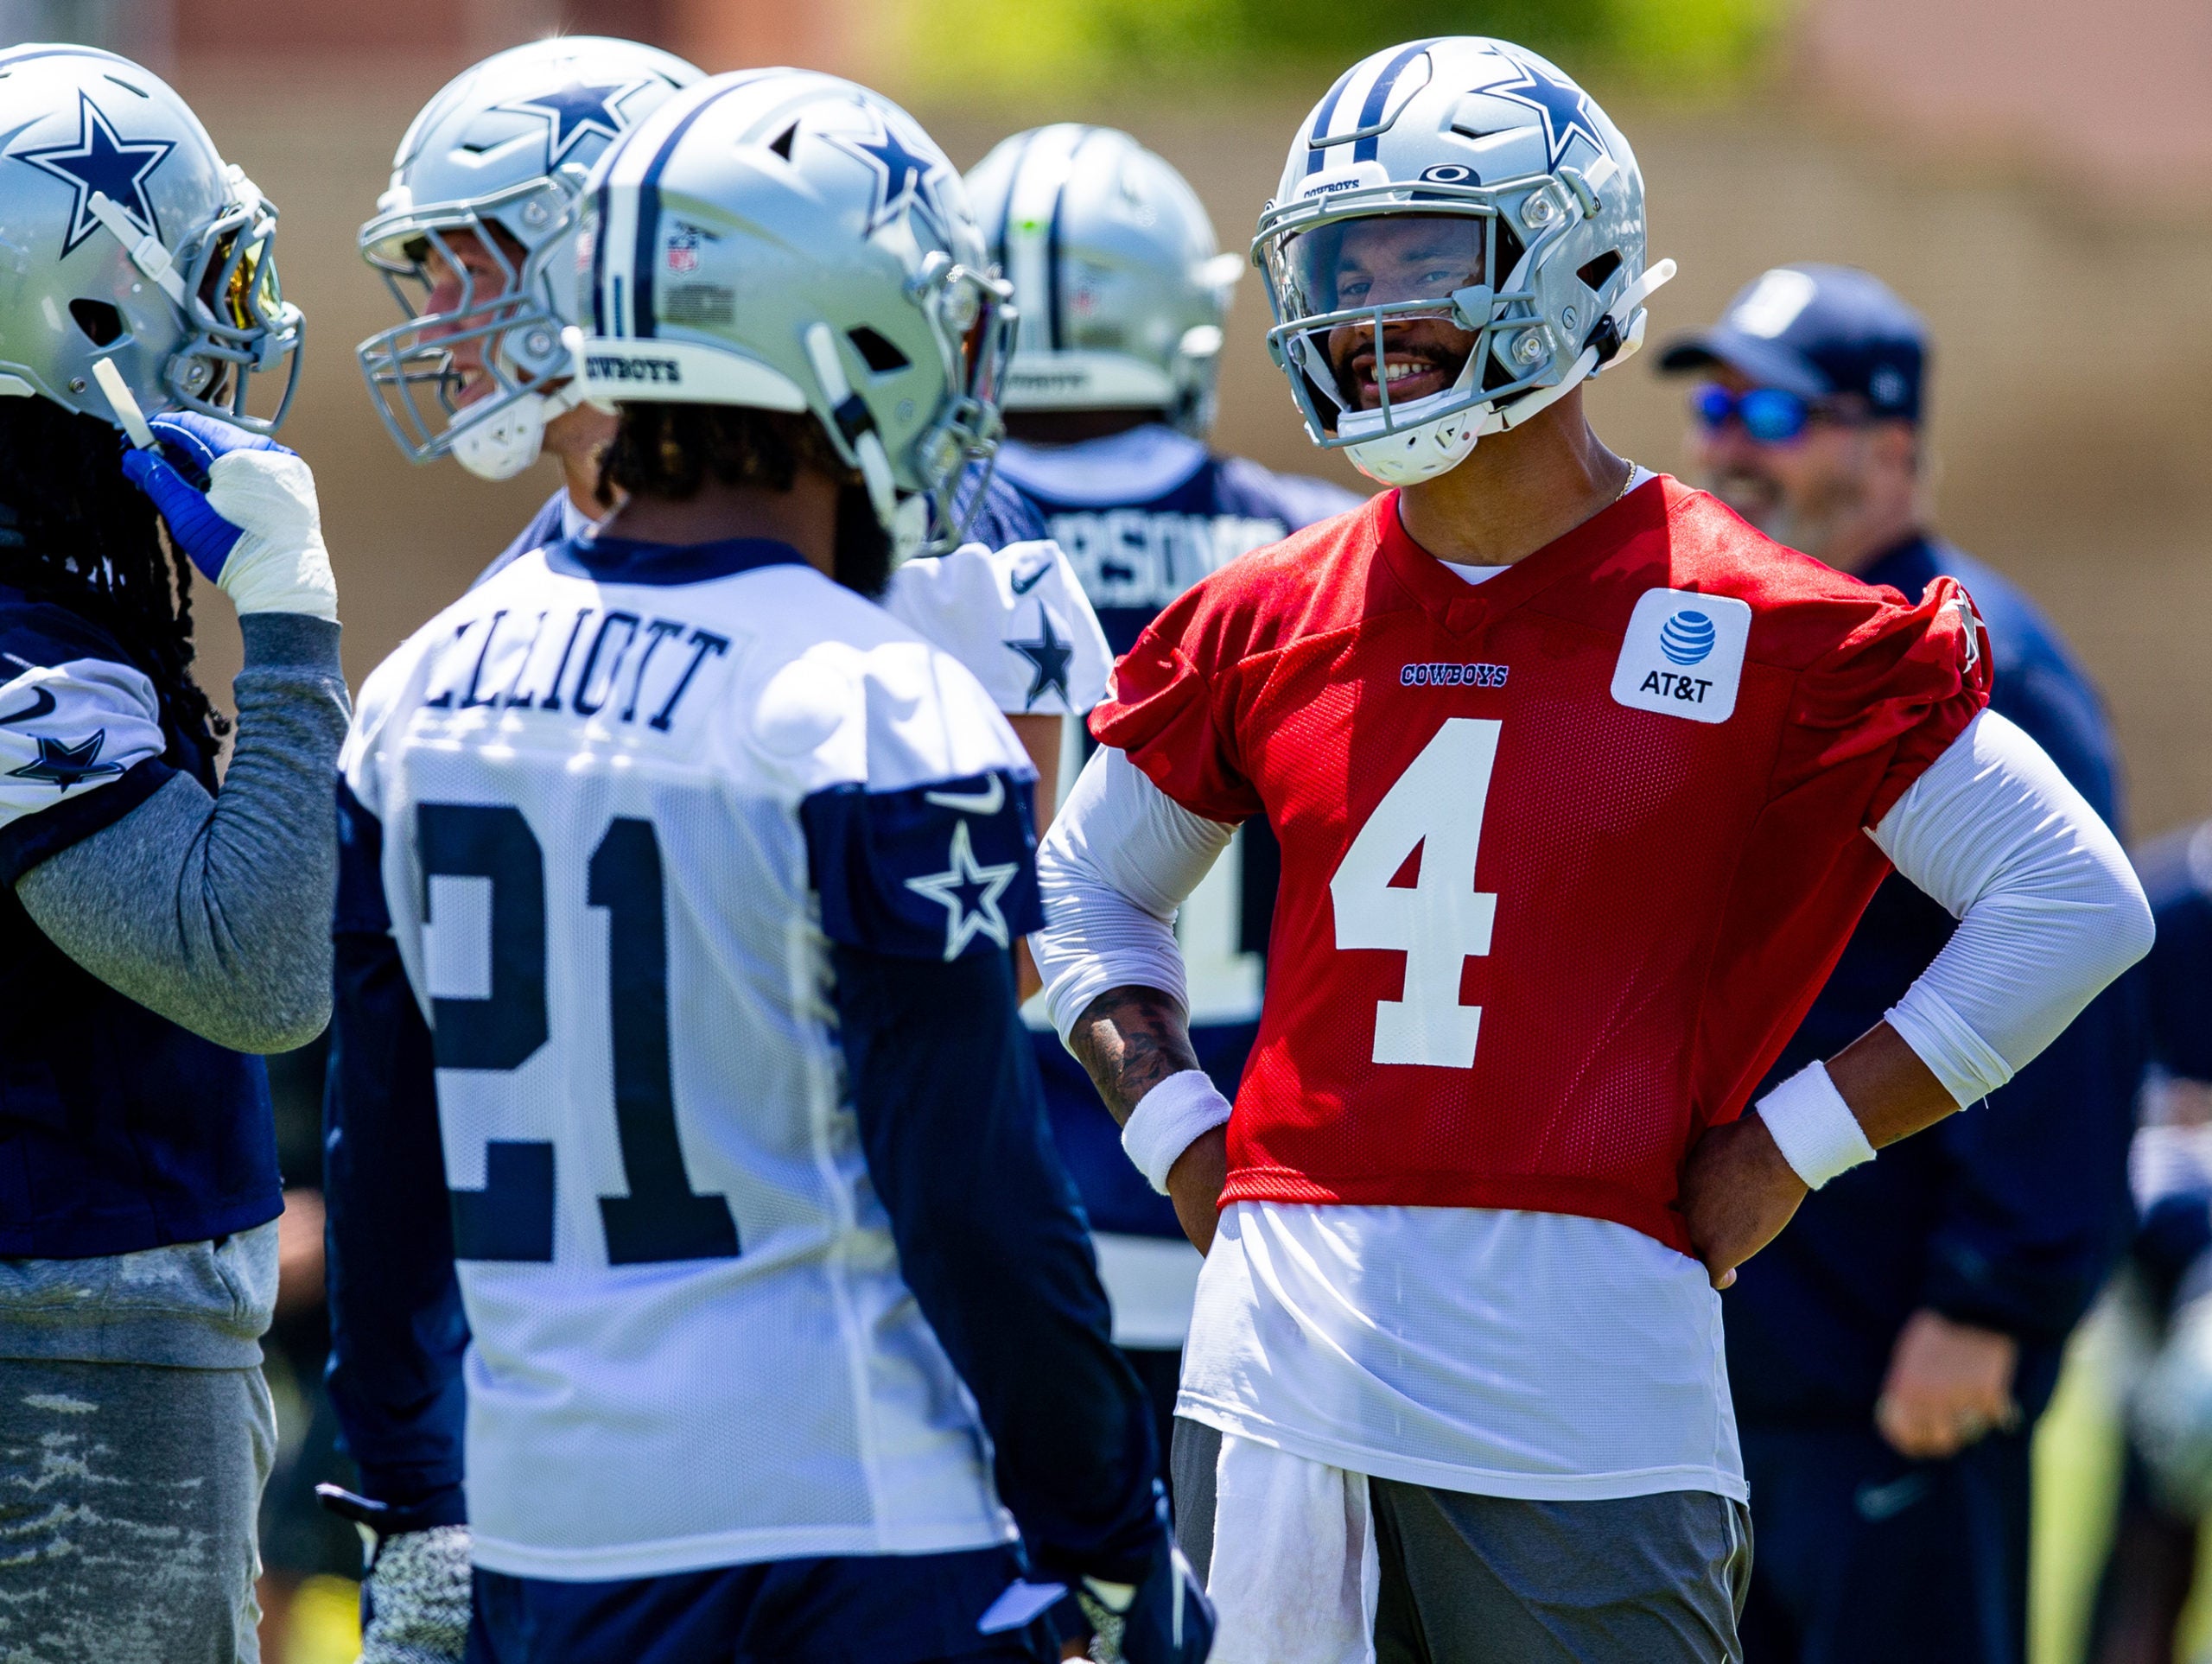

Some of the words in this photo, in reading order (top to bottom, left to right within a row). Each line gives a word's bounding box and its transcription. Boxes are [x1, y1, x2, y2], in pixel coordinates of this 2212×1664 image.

[1400, 663, 1509, 688] COWBOYS
[1639, 670, 1713, 703] AT&T
[1329, 717, 1503, 1069] 4
[416, 803, 741, 1267] 21
